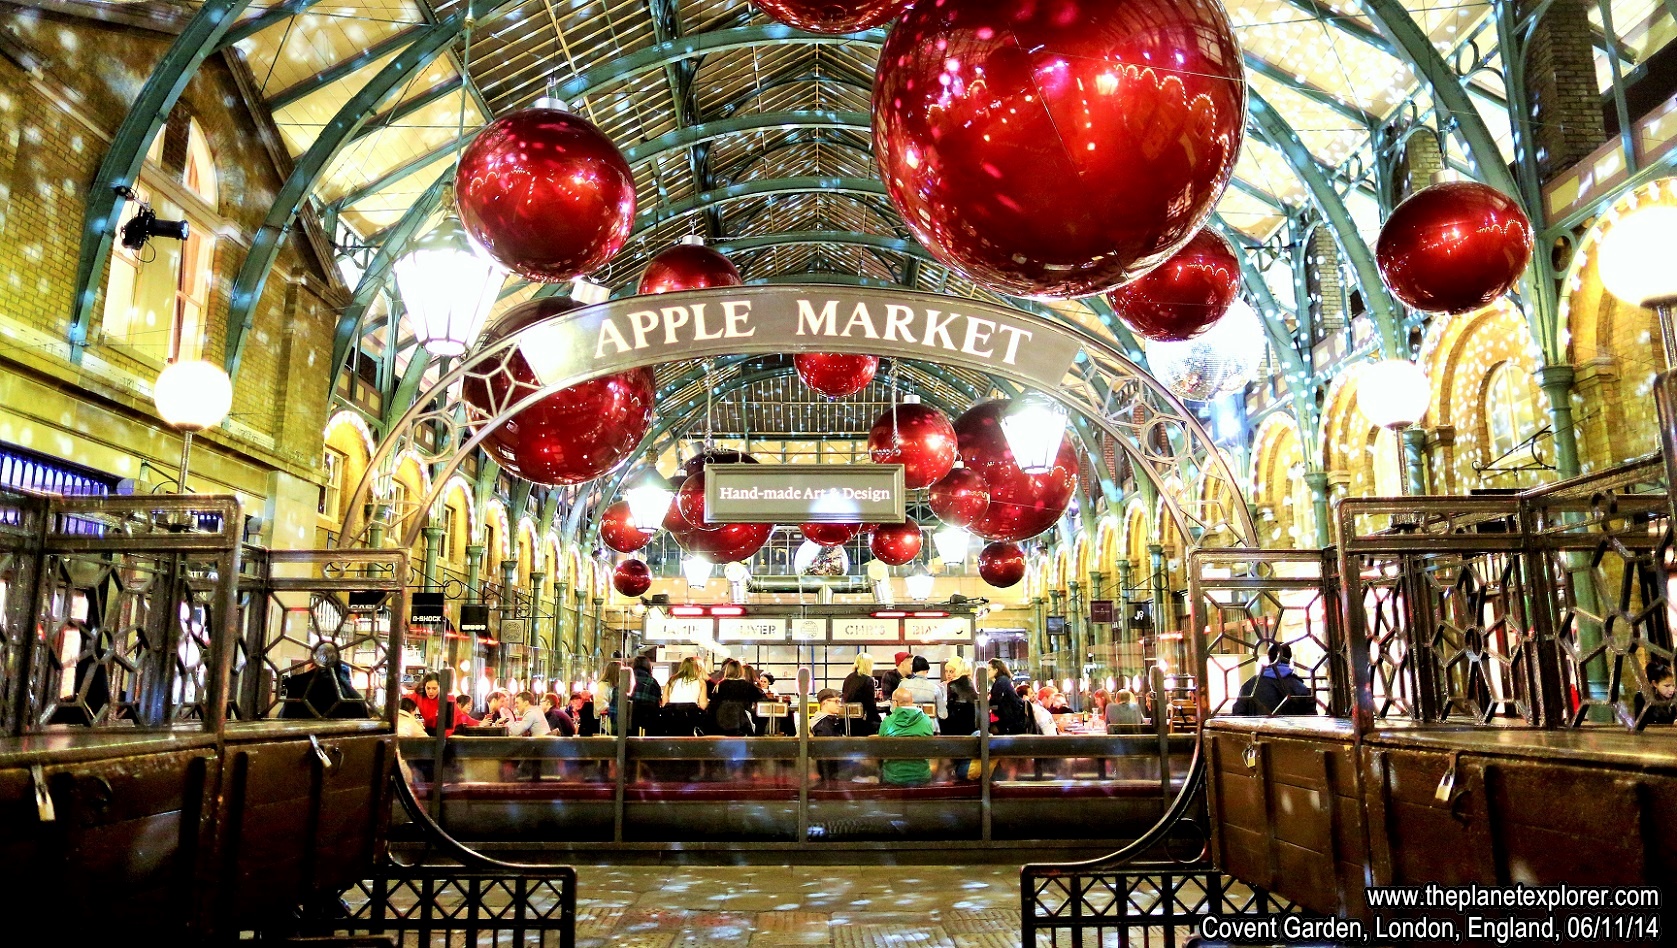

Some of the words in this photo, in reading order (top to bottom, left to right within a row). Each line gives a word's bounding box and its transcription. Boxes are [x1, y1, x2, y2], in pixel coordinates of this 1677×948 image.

[593, 300, 756, 359] APPLE
[796, 299, 1033, 366] MARKET
[719, 486, 802, 500] Hand-made
[803, 487, 826, 500] Art
[829, 487, 840, 500] &
[843, 487, 891, 503] Design
[845, 624, 886, 636] CHRIS
